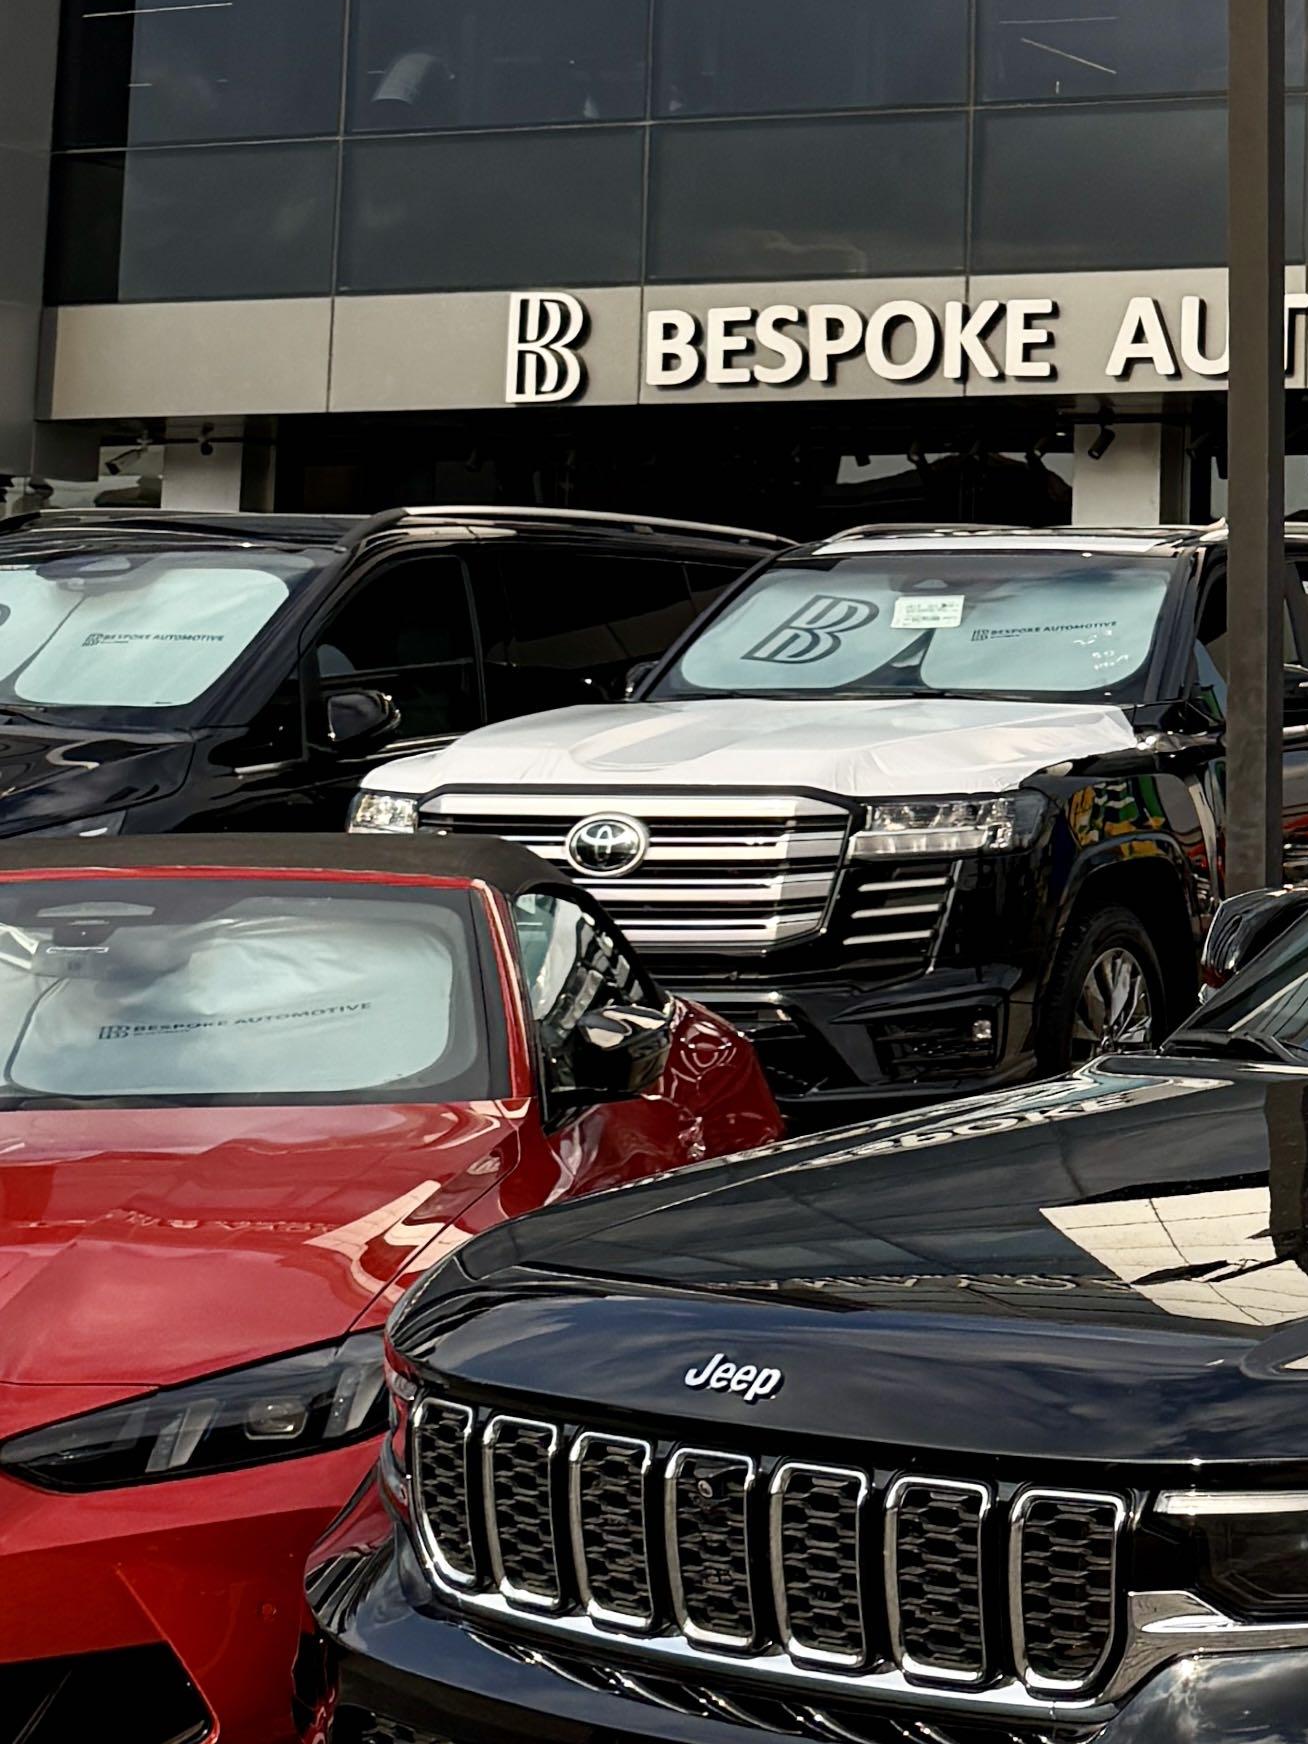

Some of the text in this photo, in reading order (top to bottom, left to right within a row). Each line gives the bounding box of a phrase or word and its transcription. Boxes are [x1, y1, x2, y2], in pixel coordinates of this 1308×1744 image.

[646, 297, 1054, 384] BESPOKE
[1043, 621, 1117, 632] AUTOMOTIVE
[133, 1020, 228, 1033] BESPOKE
[234, 1002, 372, 1025] AUTOMOTIVE
[685, 1353, 782, 1401] Jeep
